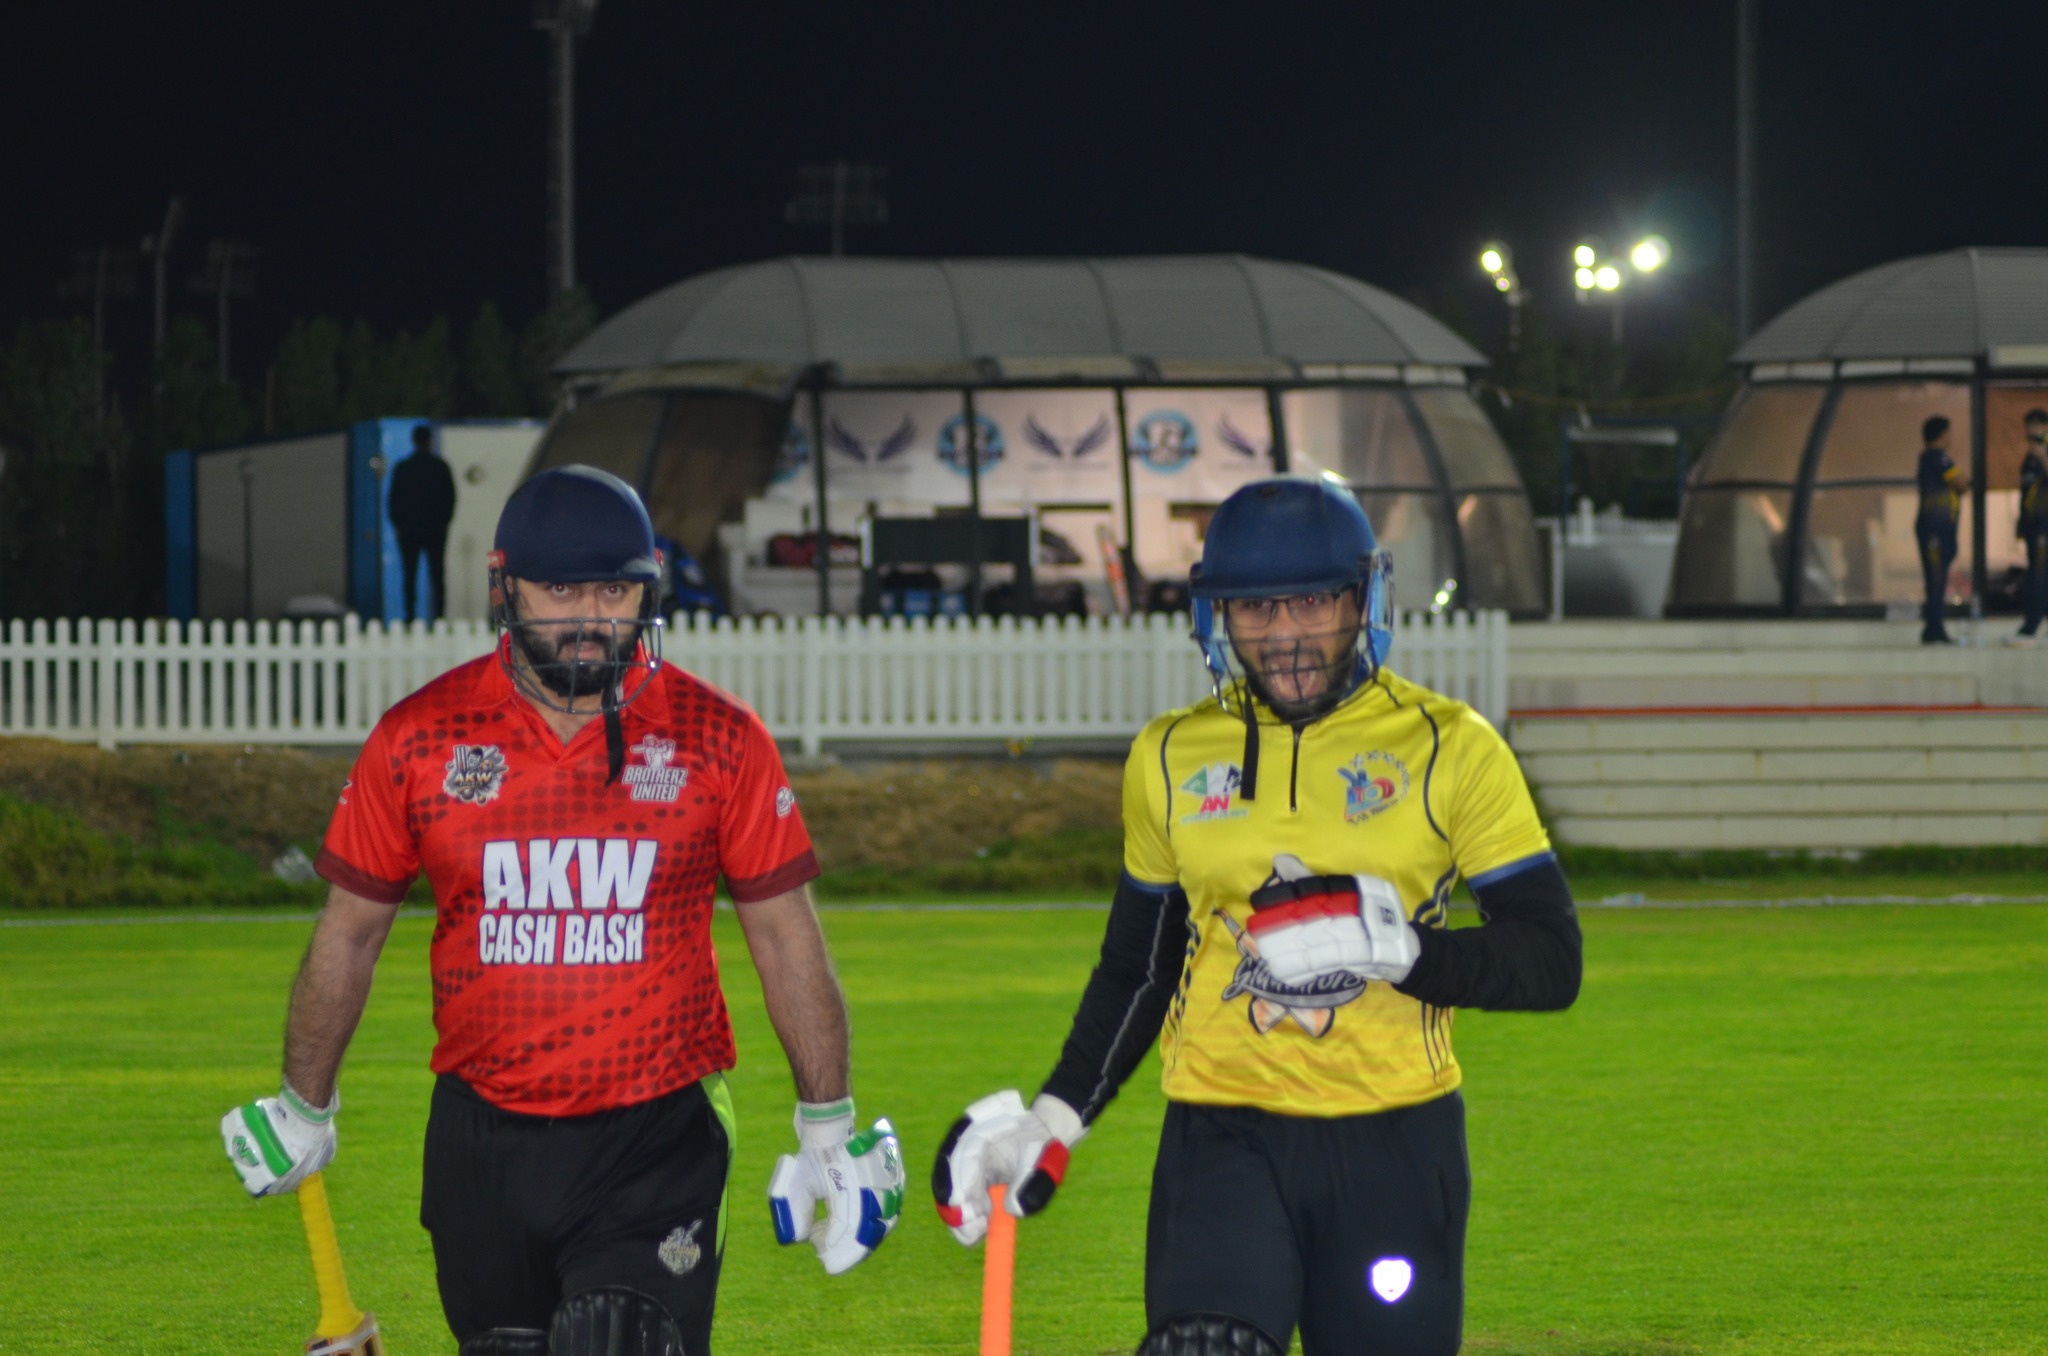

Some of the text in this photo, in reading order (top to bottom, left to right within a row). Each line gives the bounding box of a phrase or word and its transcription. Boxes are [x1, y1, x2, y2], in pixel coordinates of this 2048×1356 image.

[454, 771, 493, 783] AKW
[623, 766, 688, 786] BROTHERZ
[632, 782, 678, 801] UNITED
[482, 838, 658, 910] AKW
[478, 912, 644, 965] CASH BASH
